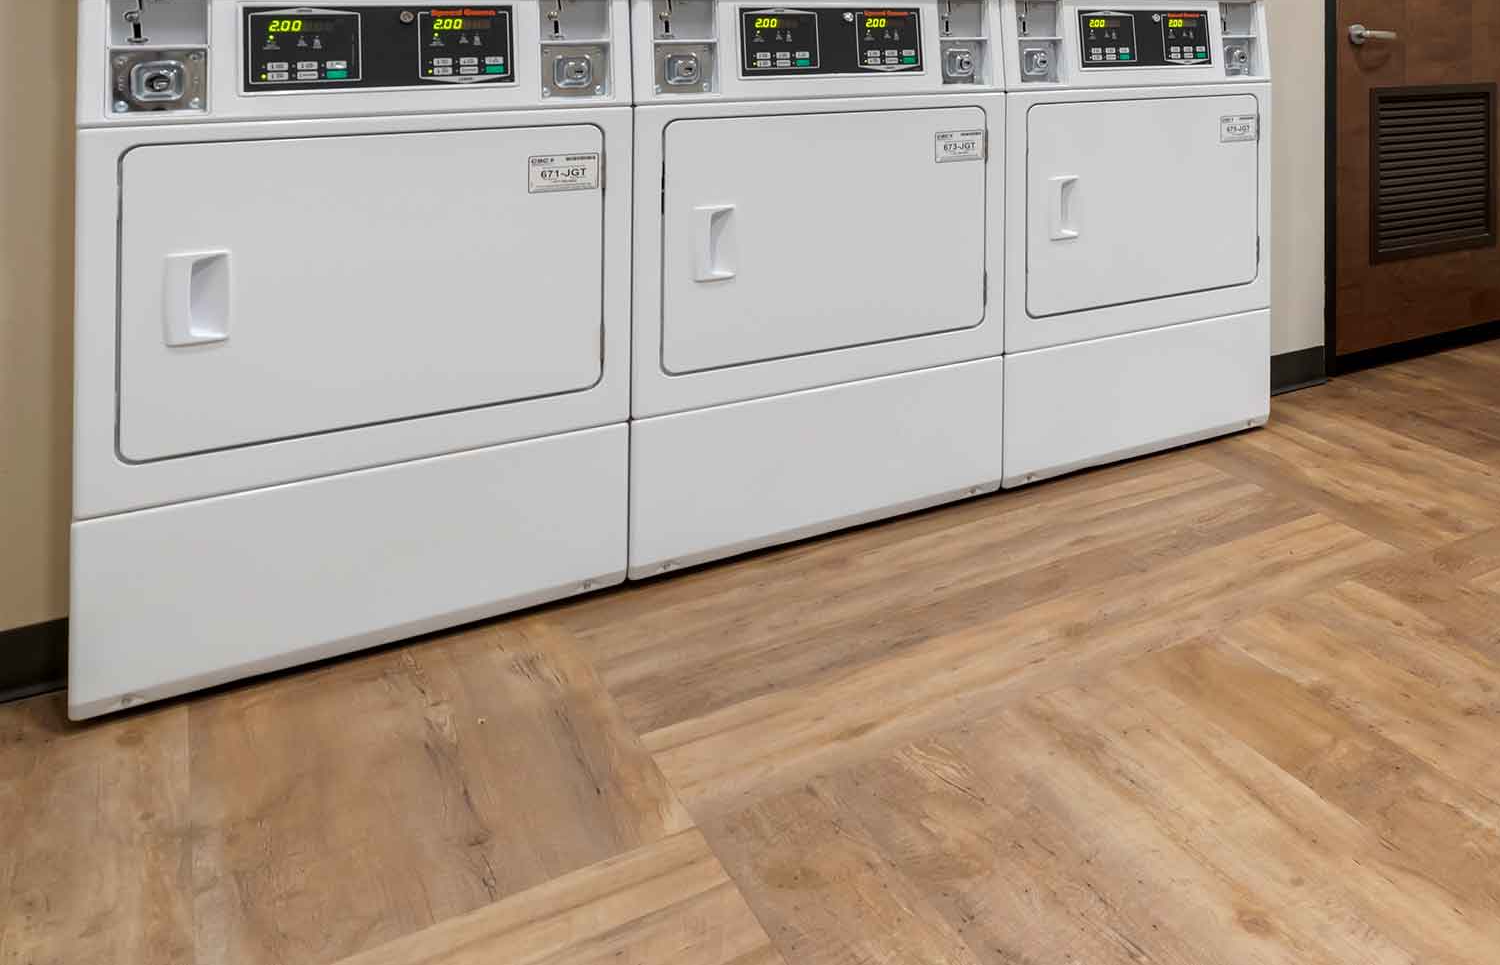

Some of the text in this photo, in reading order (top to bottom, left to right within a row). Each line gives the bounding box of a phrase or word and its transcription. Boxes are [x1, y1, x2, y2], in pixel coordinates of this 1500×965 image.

[268, 20, 303, 32] 2.00
[433, 18, 463, 30] 2.00
[755, 18, 777, 28] 2.00
[540, 167, 587, 179] 671-JGT
